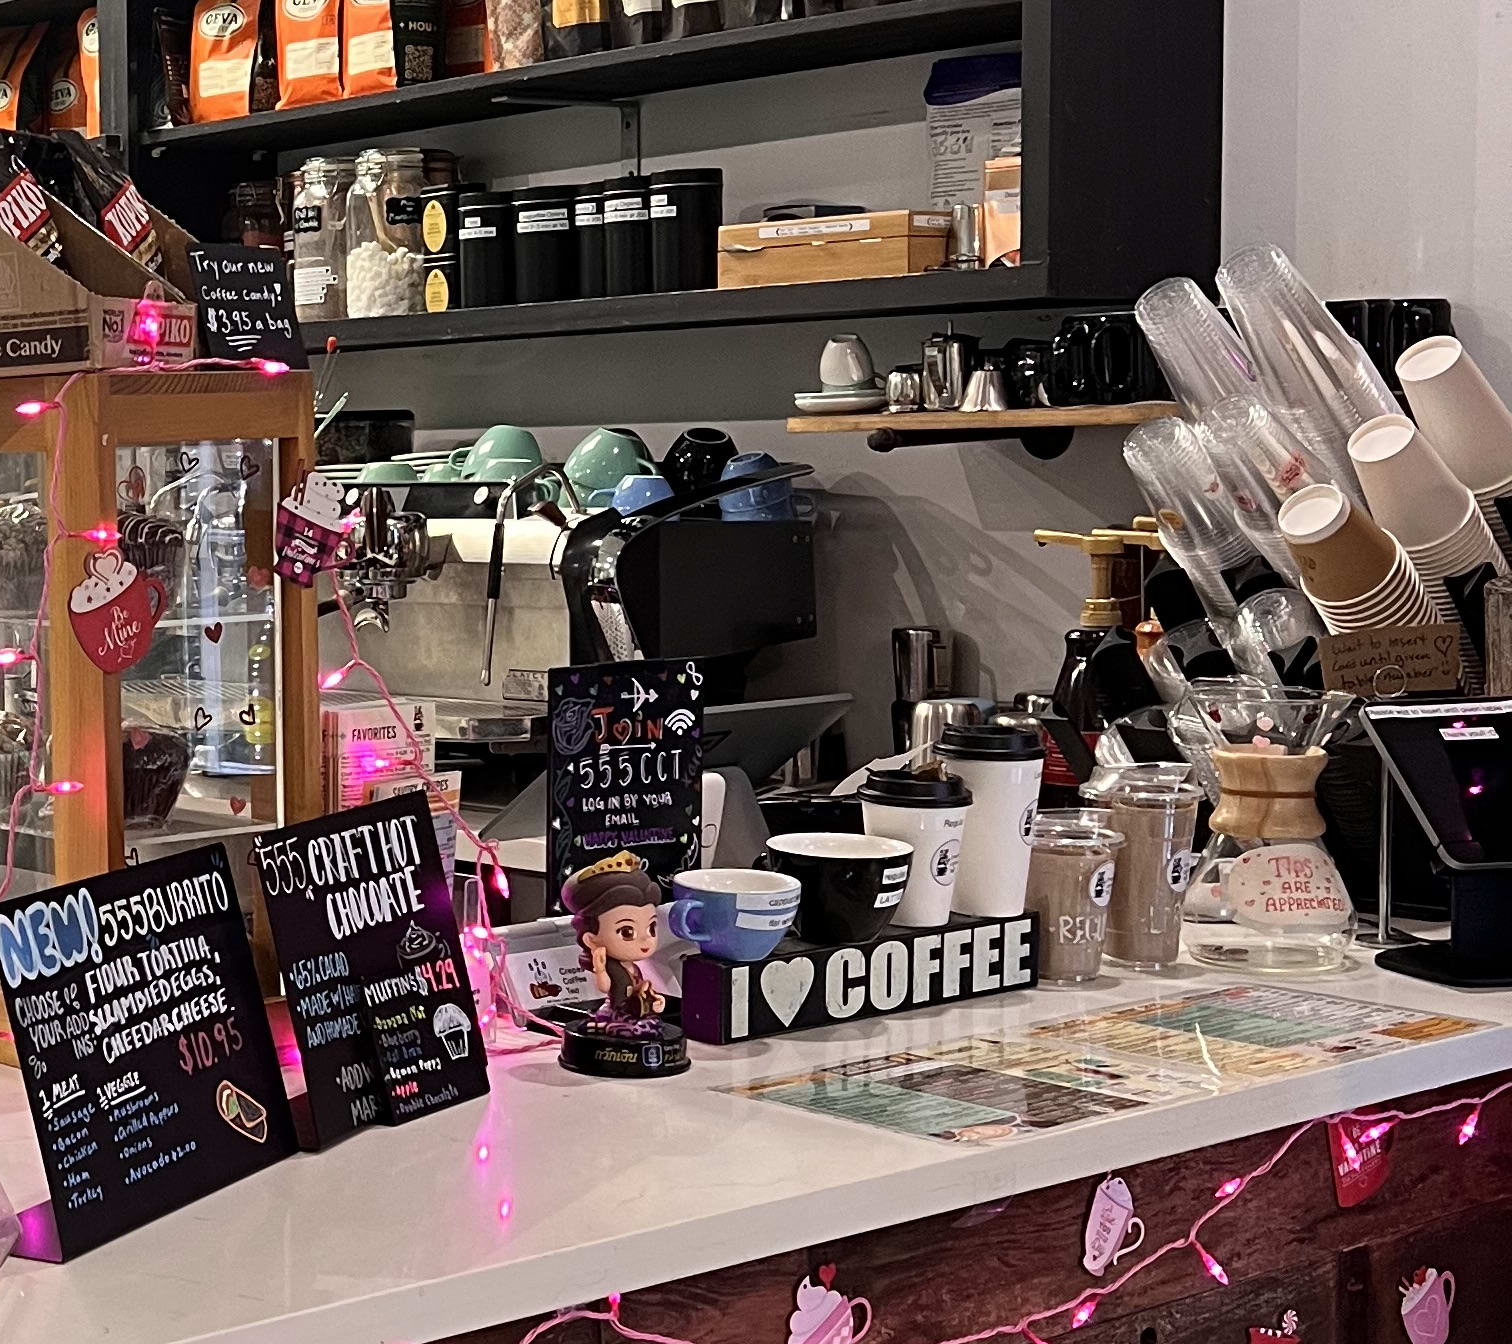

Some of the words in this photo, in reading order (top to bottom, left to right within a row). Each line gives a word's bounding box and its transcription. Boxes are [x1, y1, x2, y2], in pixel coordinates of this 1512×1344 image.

[190, 251, 220, 281] Try
[222, 258, 244, 274] our
[247, 260, 274, 274] new
[201, 284, 239, 302] Coffee
[206, 308, 252, 335] $3.95
[255, 318, 264, 331] a
[267, 311, 292, 339] bag
[6, 333, 62, 360] Candy
[111, 606, 129, 627] Be
[98, 621, 142, 656] Mine
[1369, 635, 1382, 649] to
[351, 725, 397, 742] FAVORITES
[582, 795, 605, 812] LOG
[608, 794, 621, 809] IN
[624, 793, 639, 809] BY
[643, 792, 673, 808] YOUR
[605, 813, 639, 827] EMAIL
[308, 824, 378, 886] CRAFT
[377, 815, 421, 872] HOT
[1267, 856, 1314, 879] TIPS
[1281, 881, 1311, 895] ARE
[319, 951, 350, 981] CACAO
[730, 965, 749, 1038] I
[825, 918, 1033, 1019] COFFEE
[363, 974, 418, 1007] MUFFINS
[414, 957, 461, 997] $4.29
[15, 990, 64, 1028] CHOOSE
[300, 990, 331, 1020] MADE
[29, 1020, 67, 1053] YOUR
[65, 1012, 90, 1040] ADD
[178, 1016, 244, 1076] $10.95
[52, 1073, 81, 1103] MEAT
[104, 1071, 141, 1101] VEGGIE
[340, 1063, 364, 1094] ADD
[53, 1102, 96, 1132] Sausage
[57, 1127, 90, 1151] Bacon
[63, 1141, 99, 1169] Chicken
[129, 1151, 171, 1183] Avocado
[67, 1170, 91, 1187] Ham
[71, 1185, 105, 1209] Turkey
